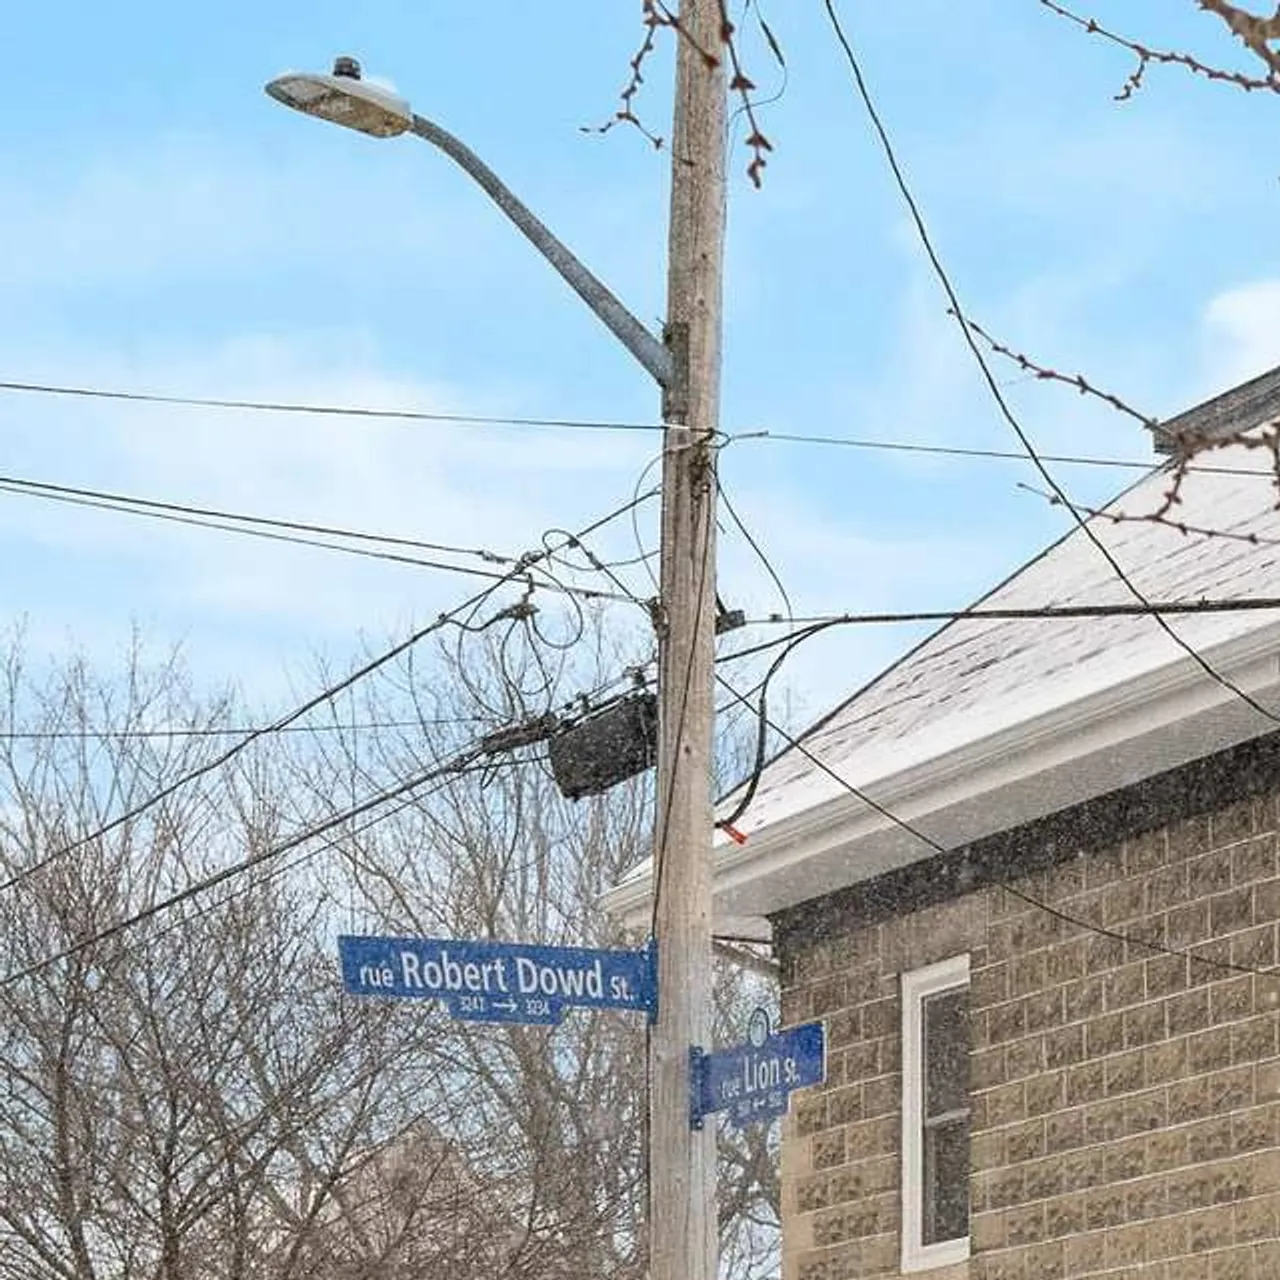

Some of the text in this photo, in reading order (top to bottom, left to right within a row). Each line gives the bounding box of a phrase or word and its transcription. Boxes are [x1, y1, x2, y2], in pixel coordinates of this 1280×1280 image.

[360, 965, 394, 988] rue
[400, 950, 509, 992] Robert
[515, 956, 604, 998] Dowd
[744, 1053, 780, 1093] Lion
